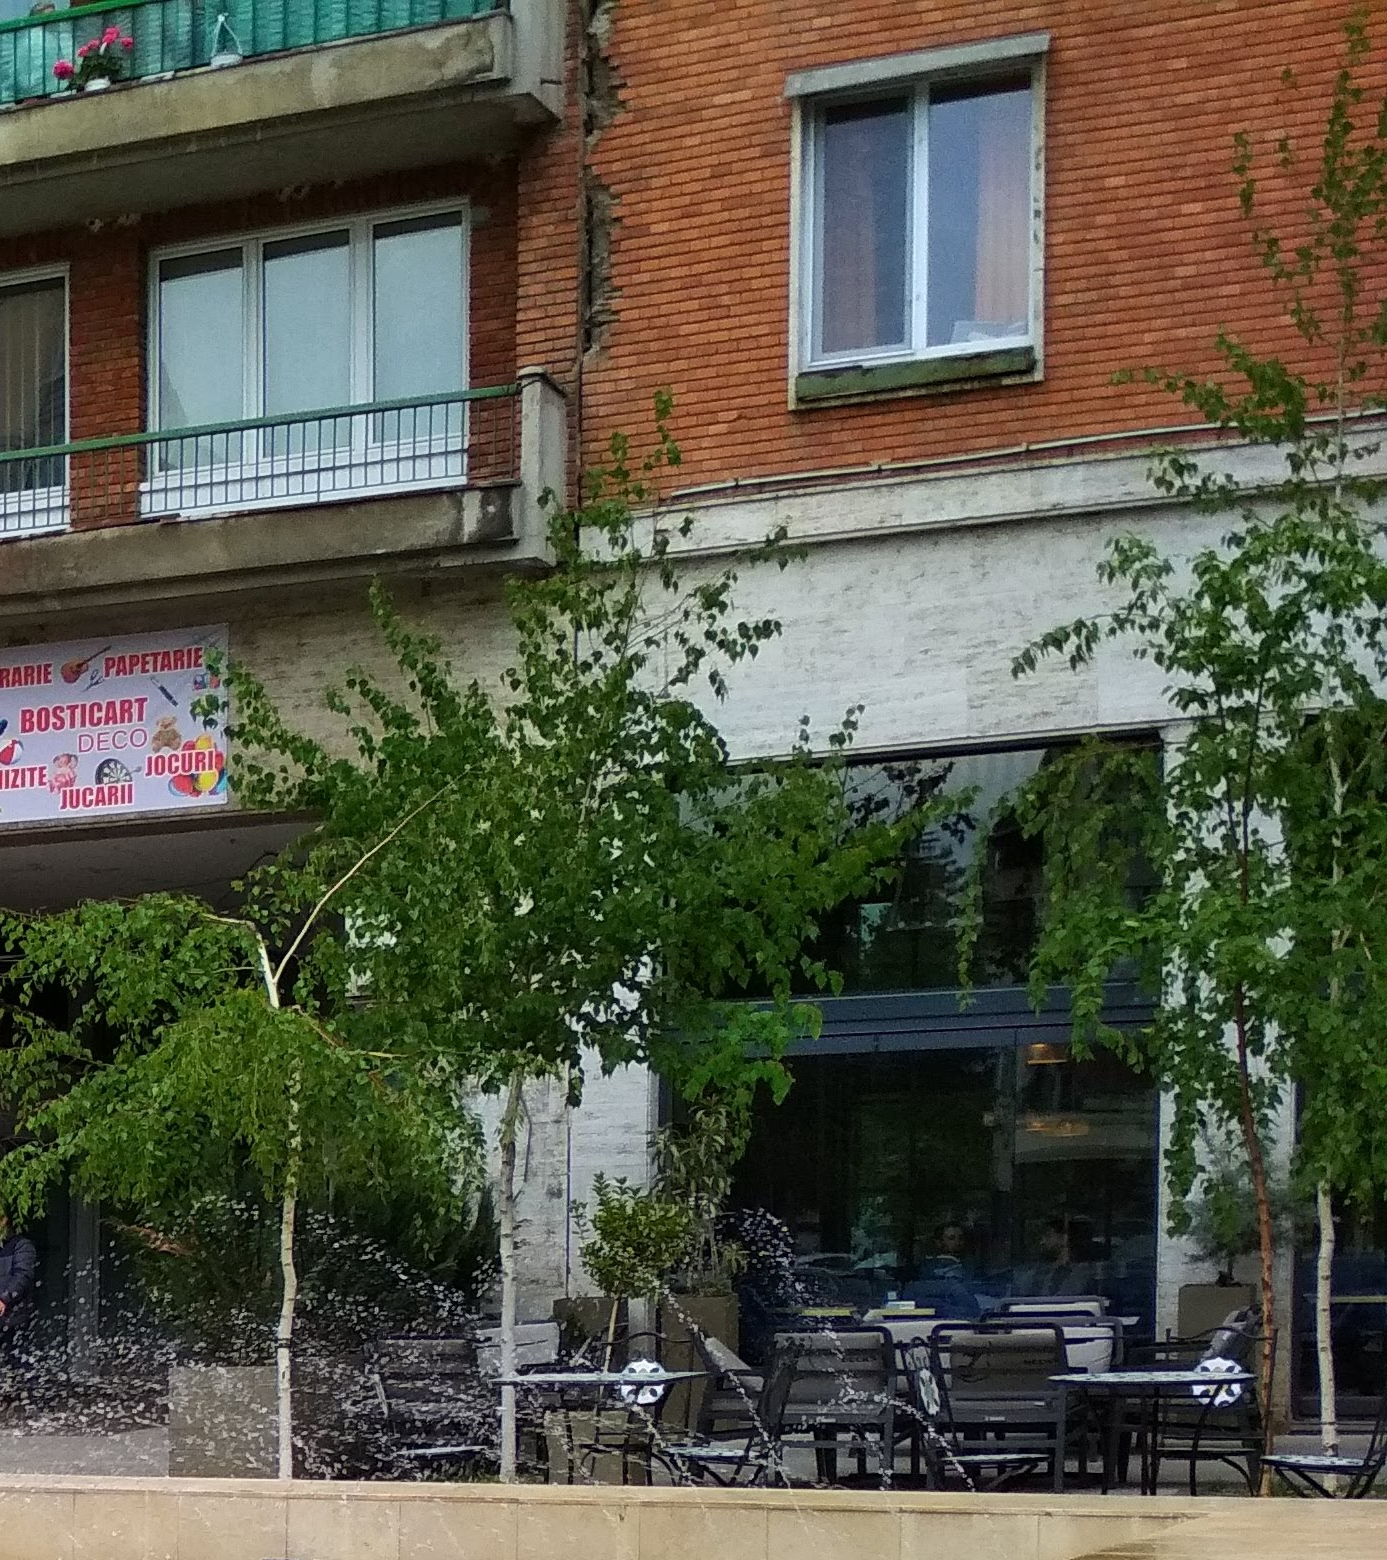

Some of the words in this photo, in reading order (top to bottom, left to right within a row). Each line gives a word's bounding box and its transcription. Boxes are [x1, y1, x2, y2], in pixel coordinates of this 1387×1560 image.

[103, 646, 204, 678] PAPETARIE
[19, 697, 149, 734] BOSTICART
[78, 728, 148, 753] DECO
[145, 750, 216, 777] JOCURI
[60, 783, 134, 810] JUCARII
